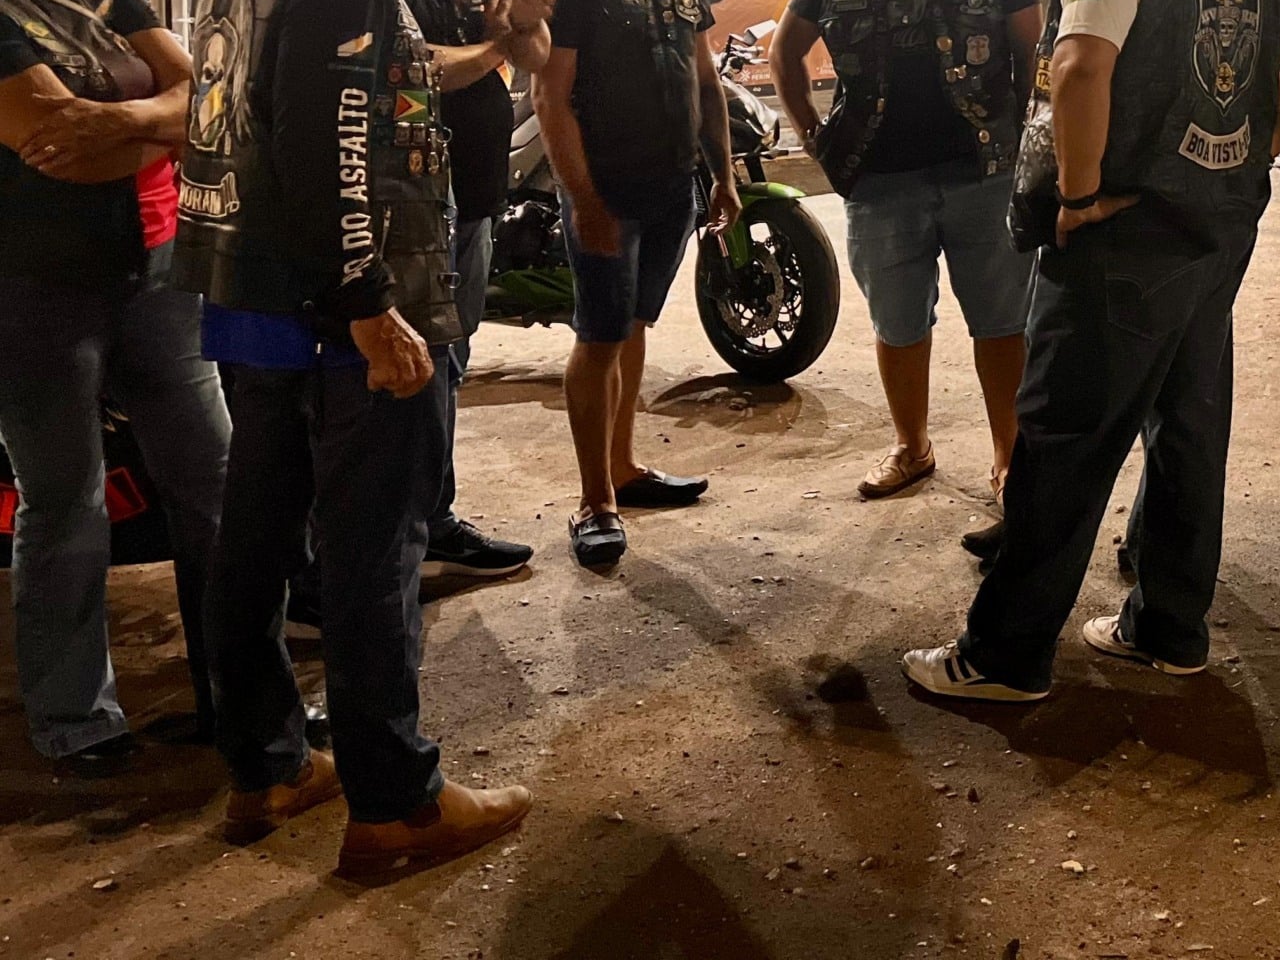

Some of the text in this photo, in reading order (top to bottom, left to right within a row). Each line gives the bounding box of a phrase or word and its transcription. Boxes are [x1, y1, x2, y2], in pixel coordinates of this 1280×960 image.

[338, 87, 369, 203] ASFALTO
[1186, 132, 1210, 162] BOA
[341, 213, 373, 250] DO
